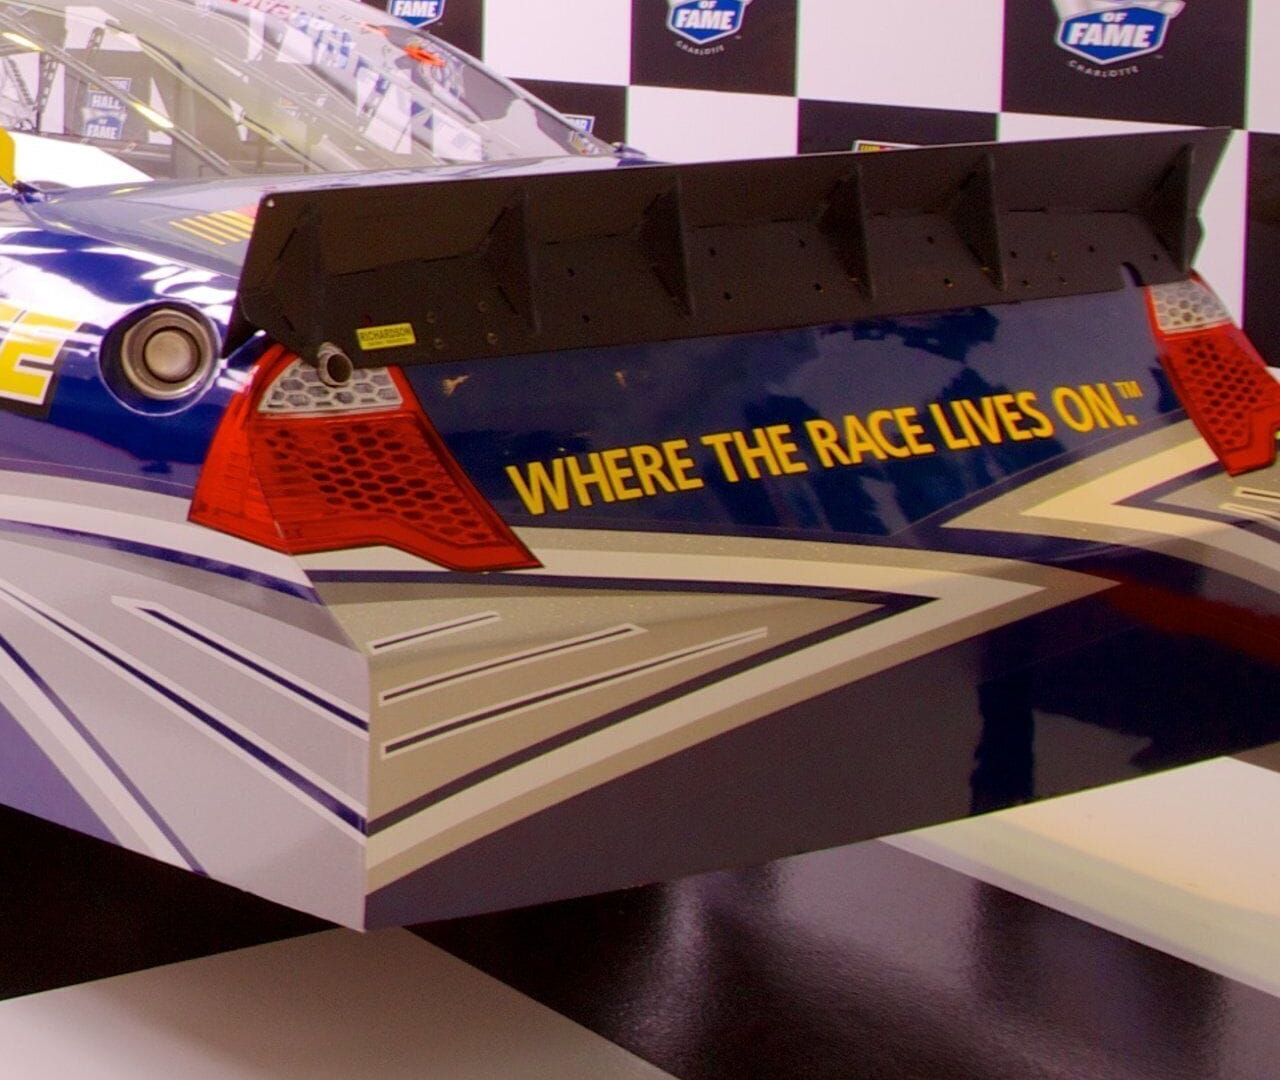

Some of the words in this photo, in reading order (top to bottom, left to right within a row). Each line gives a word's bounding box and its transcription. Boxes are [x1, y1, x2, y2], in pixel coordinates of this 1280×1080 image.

[393, 0, 438, 17] FAME
[698, 0, 717, 9] OF
[675, 9, 736, 30] FAME
[1101, 12, 1128, 22] OF
[1066, 23, 1155, 48] FAME
[505, 438, 703, 515] WHERE
[703, 423, 807, 483] THE
[805, 406, 936, 469] RACE
[928, 392, 1054, 451] LIVES
